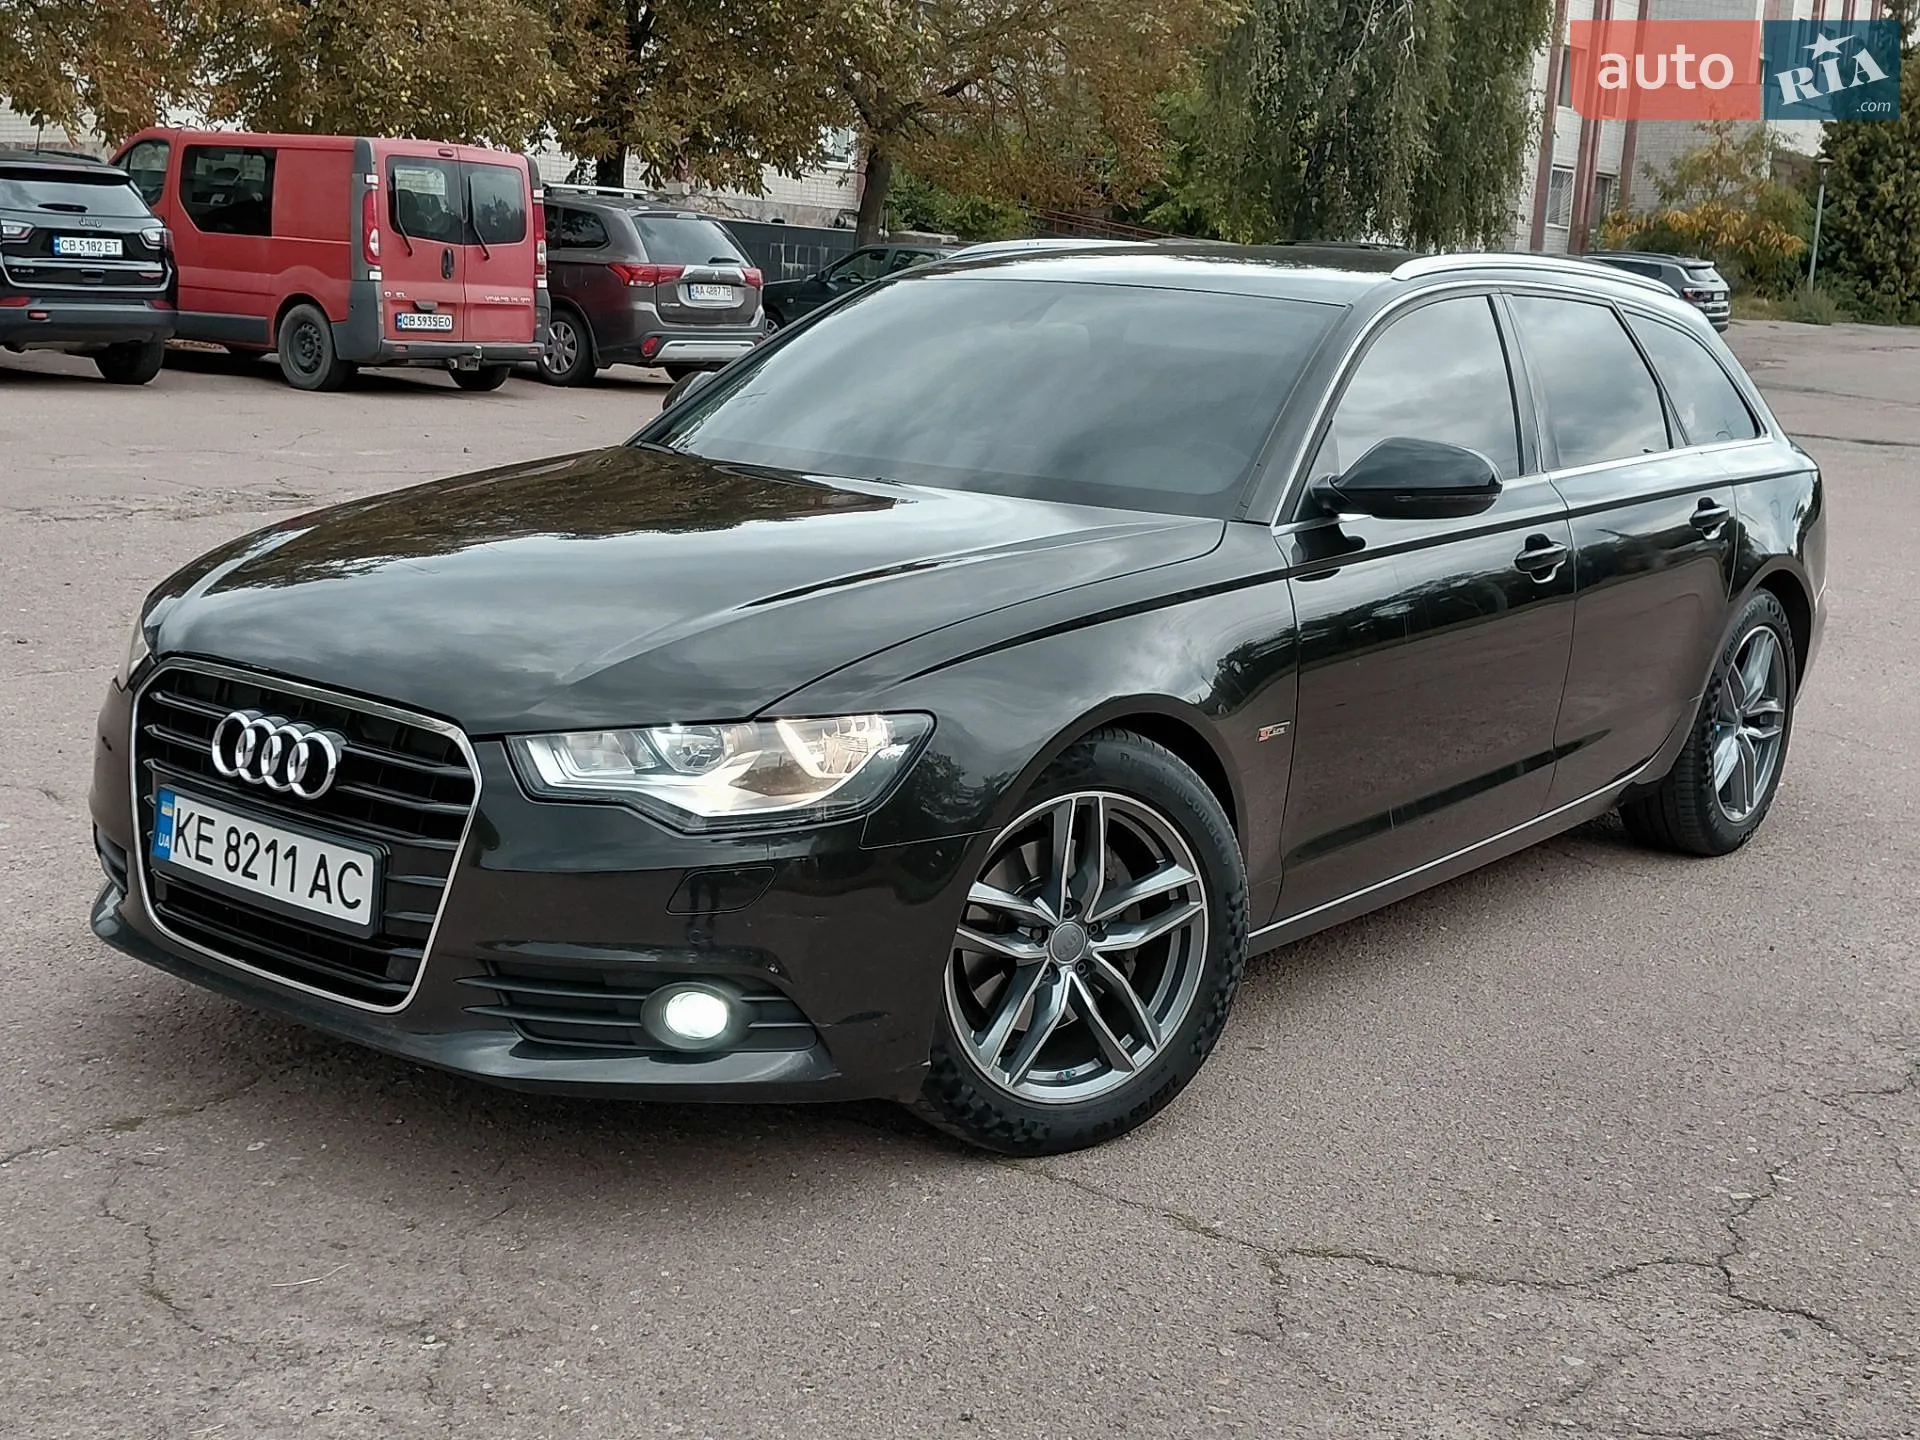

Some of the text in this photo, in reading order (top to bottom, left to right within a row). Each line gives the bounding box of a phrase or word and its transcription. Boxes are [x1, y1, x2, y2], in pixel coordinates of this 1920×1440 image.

[79, 217, 103, 228] Jeep
[61, 239, 119, 253] CB 5182 ET
[402, 316, 416, 327] CB
[417, 316, 438, 327] 5935
[158, 832, 170, 849] UA
[173, 807, 363, 910] KE 8211 AC
